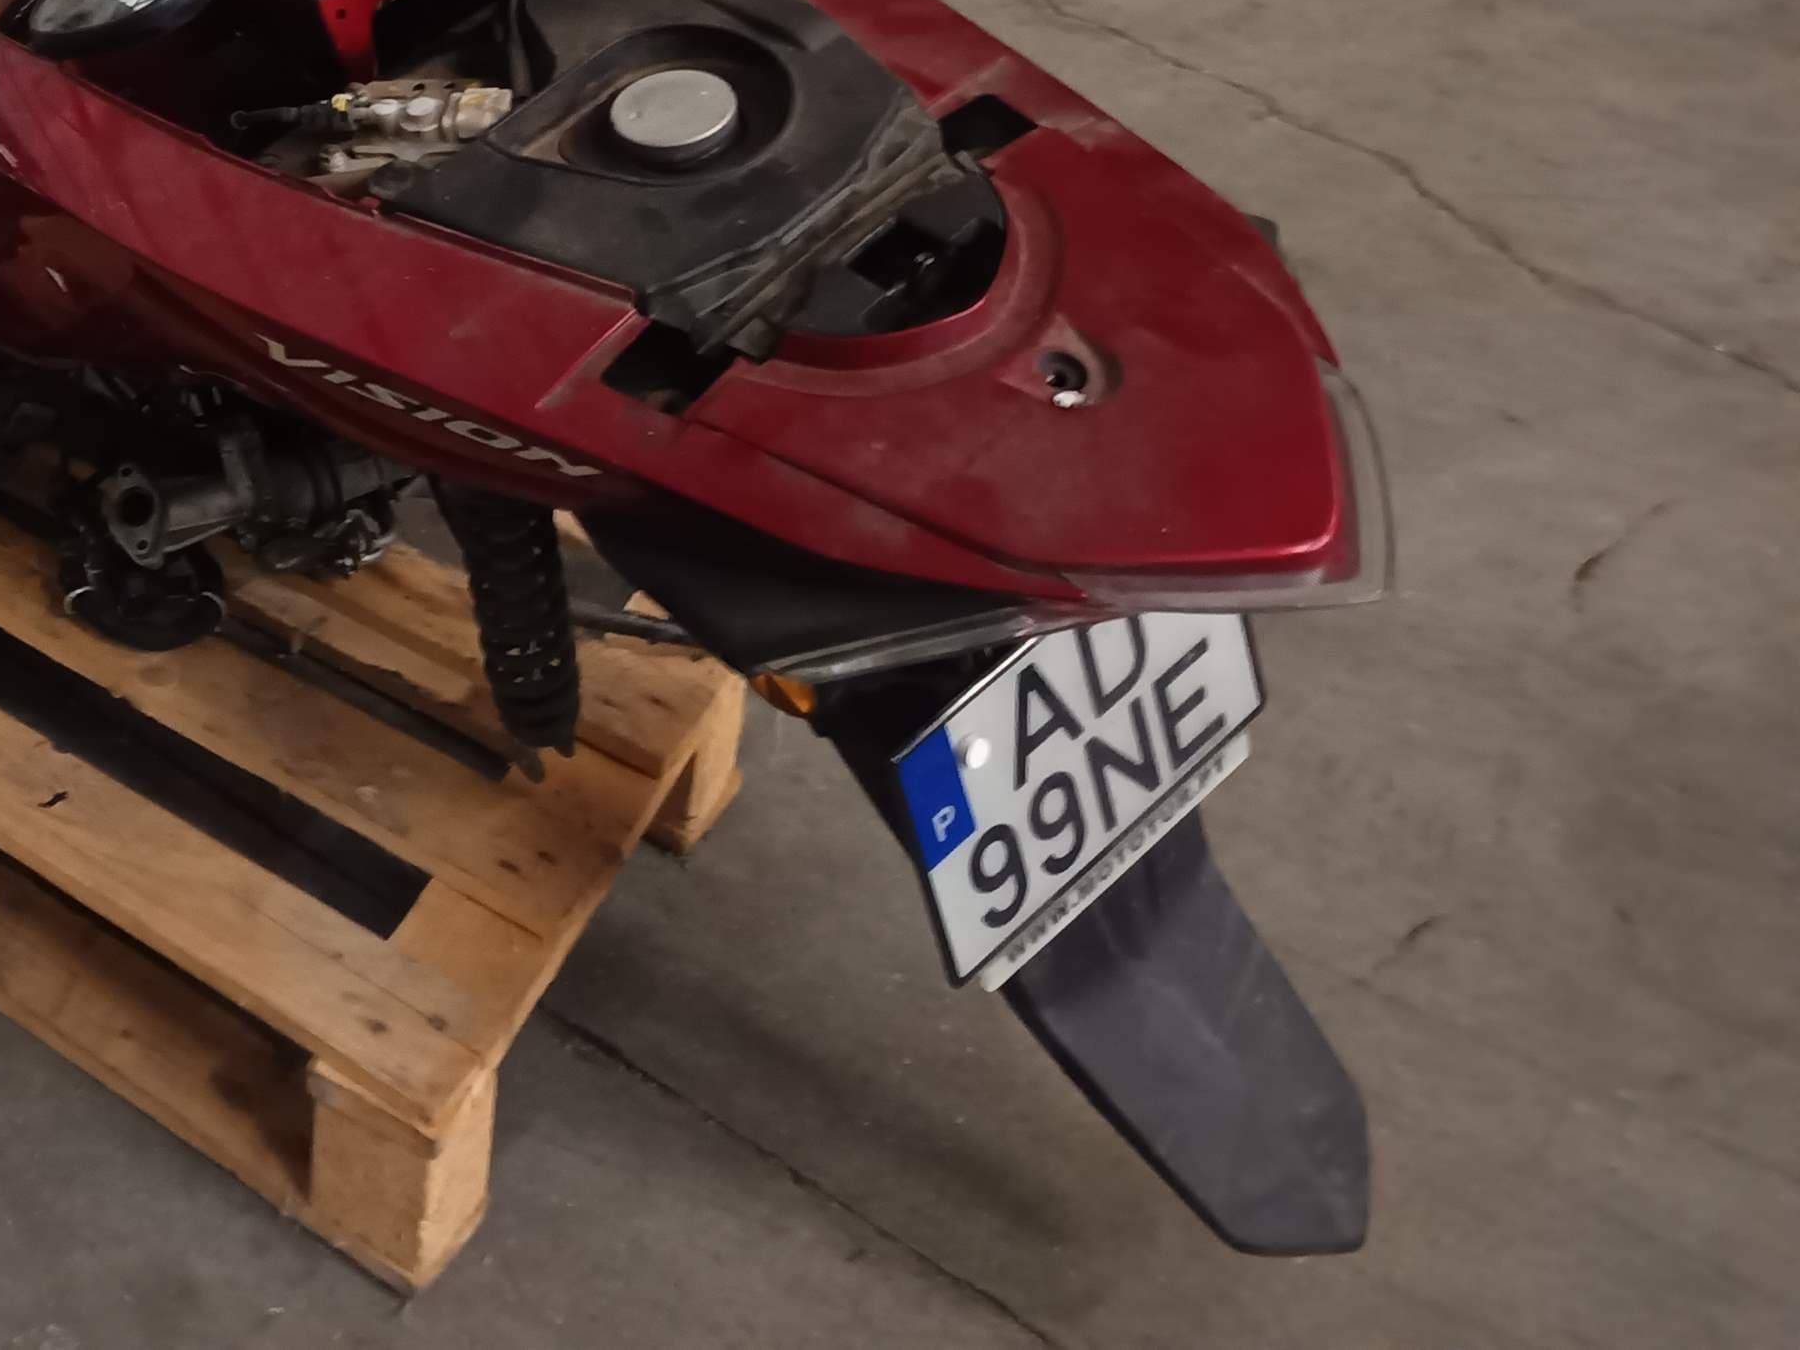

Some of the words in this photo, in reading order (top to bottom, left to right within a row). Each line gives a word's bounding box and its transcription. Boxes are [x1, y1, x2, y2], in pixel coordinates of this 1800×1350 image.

[255, 332, 603, 477] VISION
[968, 636, 1227, 929] 99NE
[1013, 614, 1146, 791] AD
[931, 805, 957, 843] P
